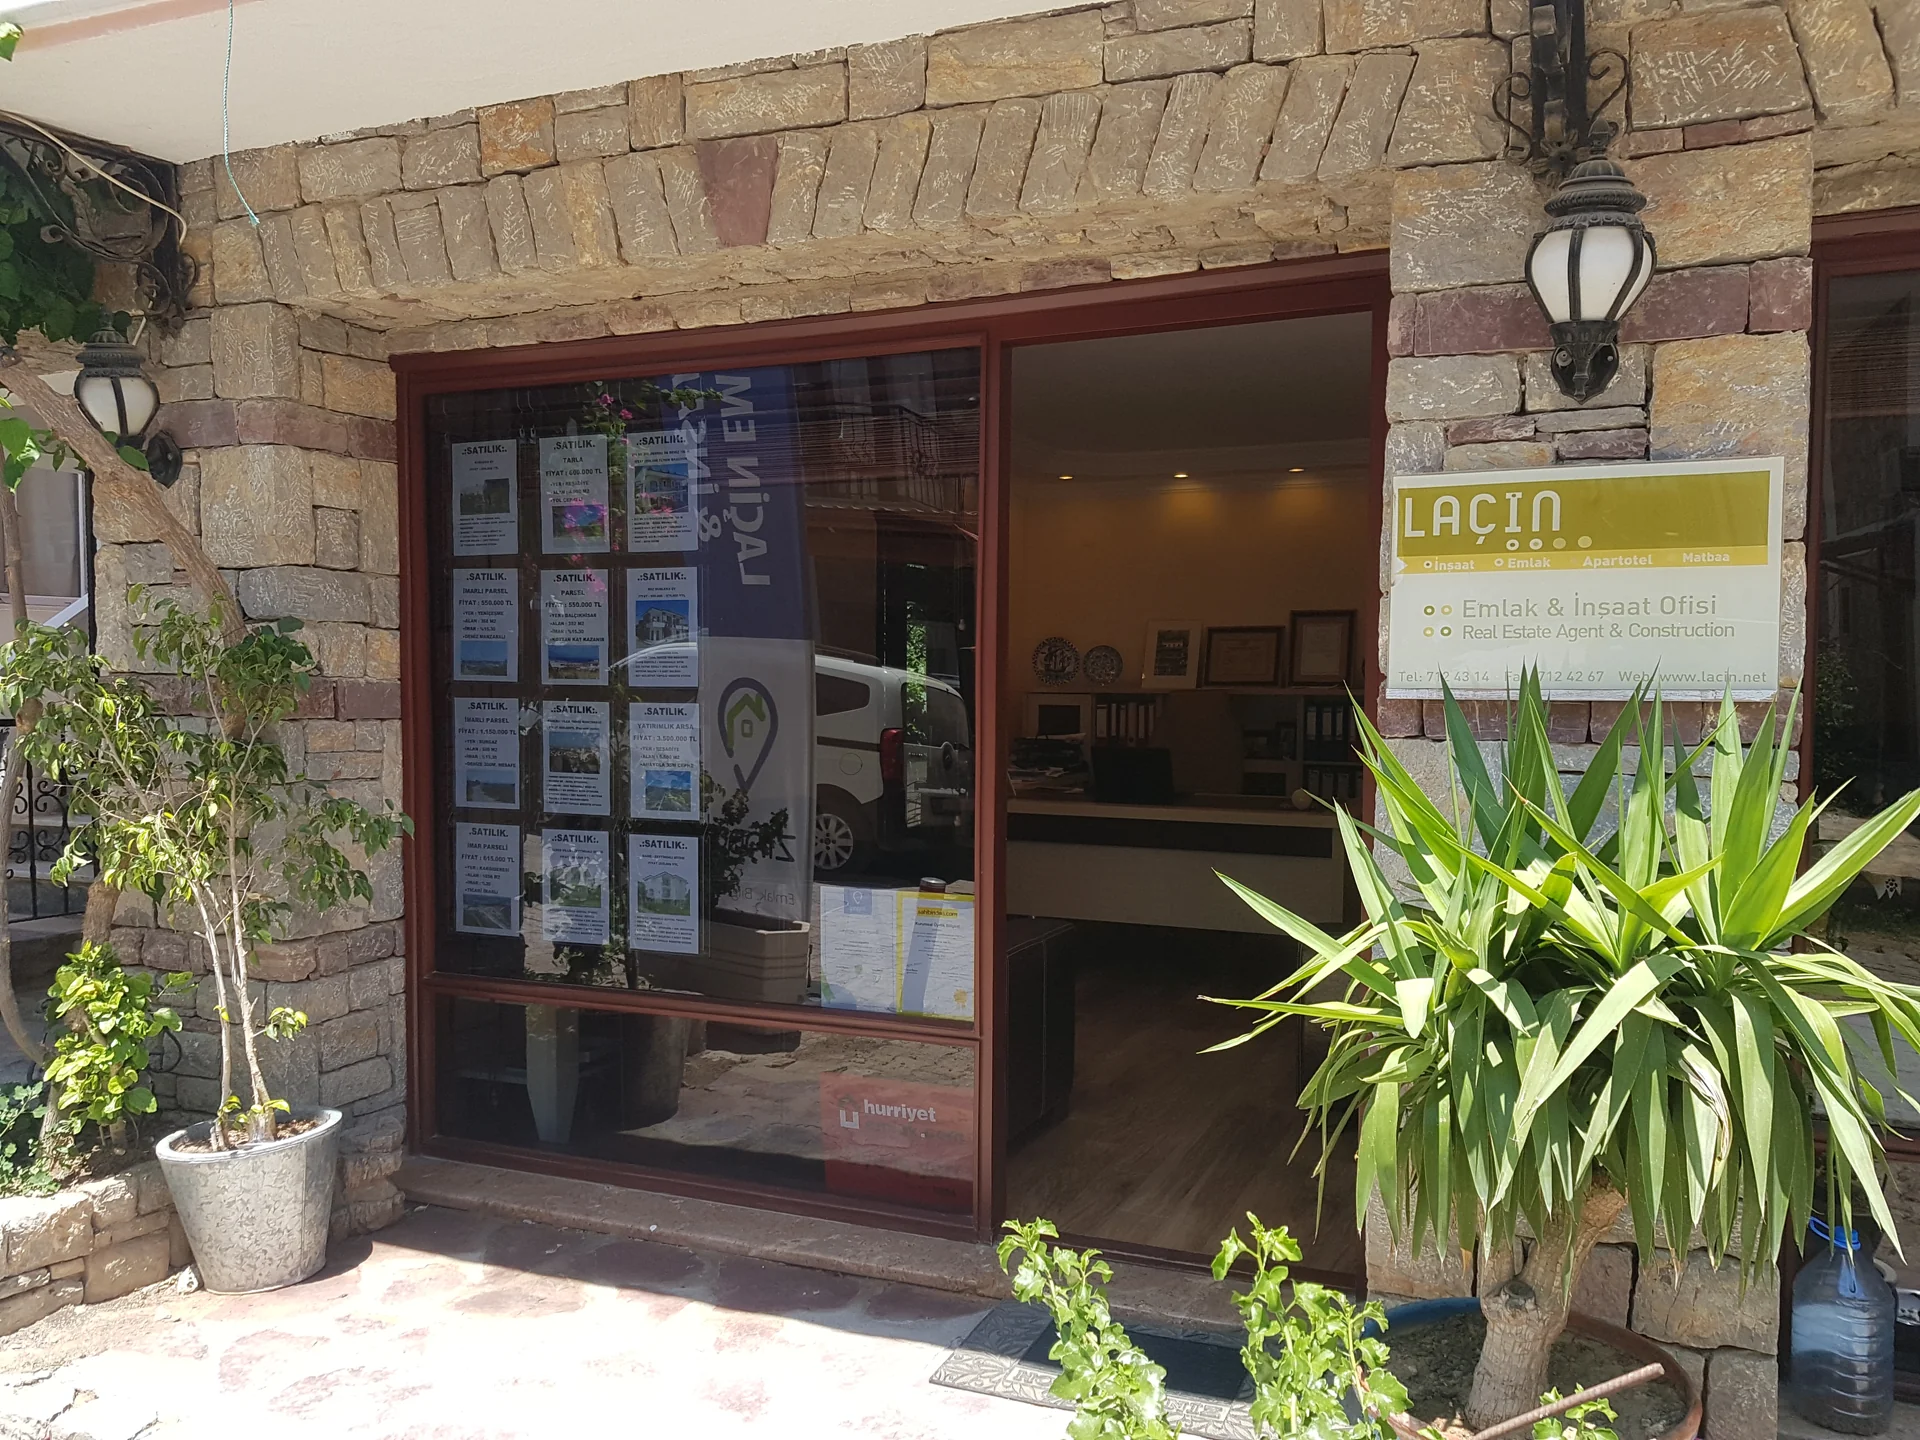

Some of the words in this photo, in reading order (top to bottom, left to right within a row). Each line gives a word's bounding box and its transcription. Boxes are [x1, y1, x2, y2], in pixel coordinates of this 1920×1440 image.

[595, 467, 603, 475] TL
[1435, 556, 1475, 572] İnşaat
[1508, 557, 1551, 569] Emlak
[1582, 554, 1653, 569] Apartotel
[1682, 552, 1730, 563] Matbaa
[1462, 597, 1538, 618] Emlak
[1547, 597, 1565, 617] &
[1575, 591, 1650, 619] İnşaat
[1659, 594, 1716, 616] Ofisi
[1462, 624, 1498, 640] Real
[1503, 623, 1552, 639] Estate
[1556, 621, 1605, 642] Agent
[1609, 622, 1623, 638] &
[1628, 621, 1735, 638] Construction
[1399, 671, 1423, 683] Tel:
[1453, 671, 1470, 683] 43
[1475, 671, 1490, 683] 14
[1566, 671, 1584, 683] 42
[1588, 671, 1605, 683] 67
[864, 1099, 937, 1123] hurriyet
